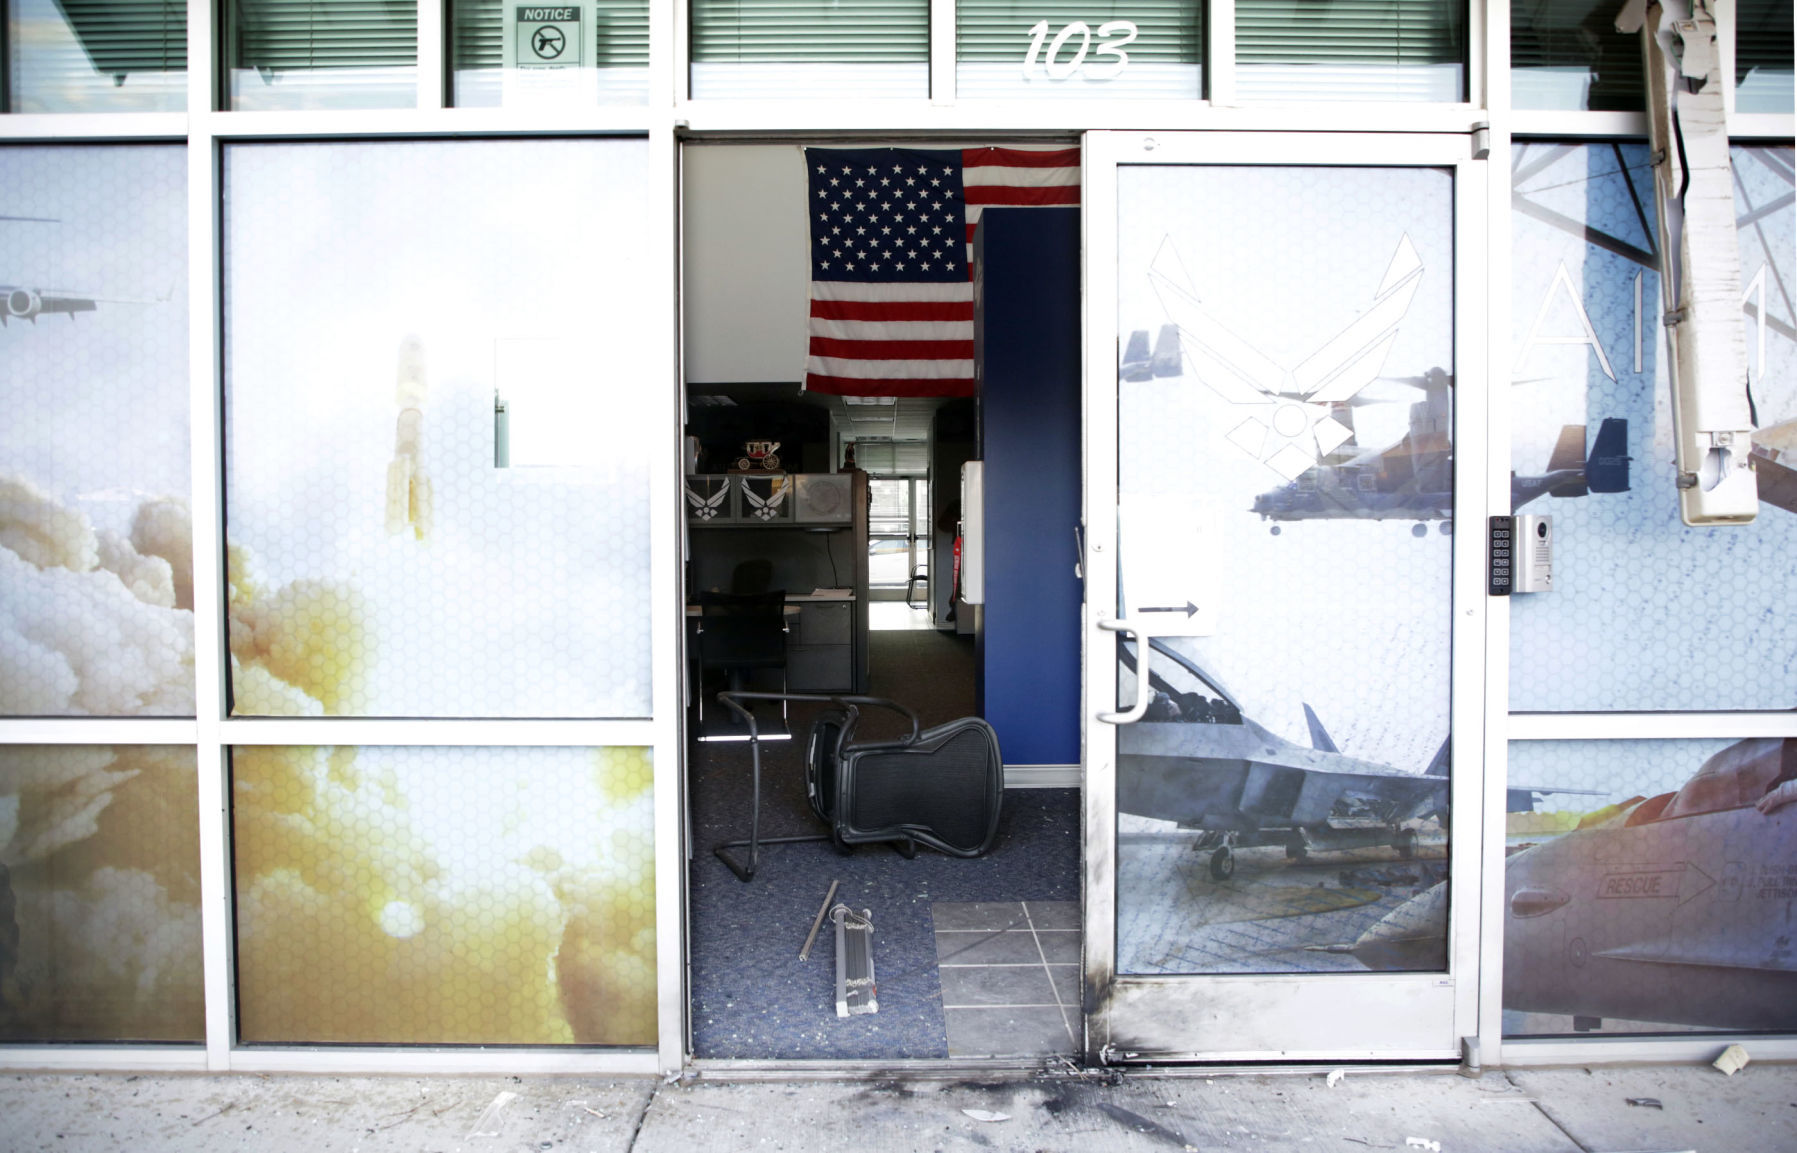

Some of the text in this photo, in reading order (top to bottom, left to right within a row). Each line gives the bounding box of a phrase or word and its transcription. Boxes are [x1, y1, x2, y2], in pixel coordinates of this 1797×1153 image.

[524, 8, 572, 20] NOTICE
[1022, 19, 1138, 81] 103
[1606, 876, 1662, 895] RESCUE
